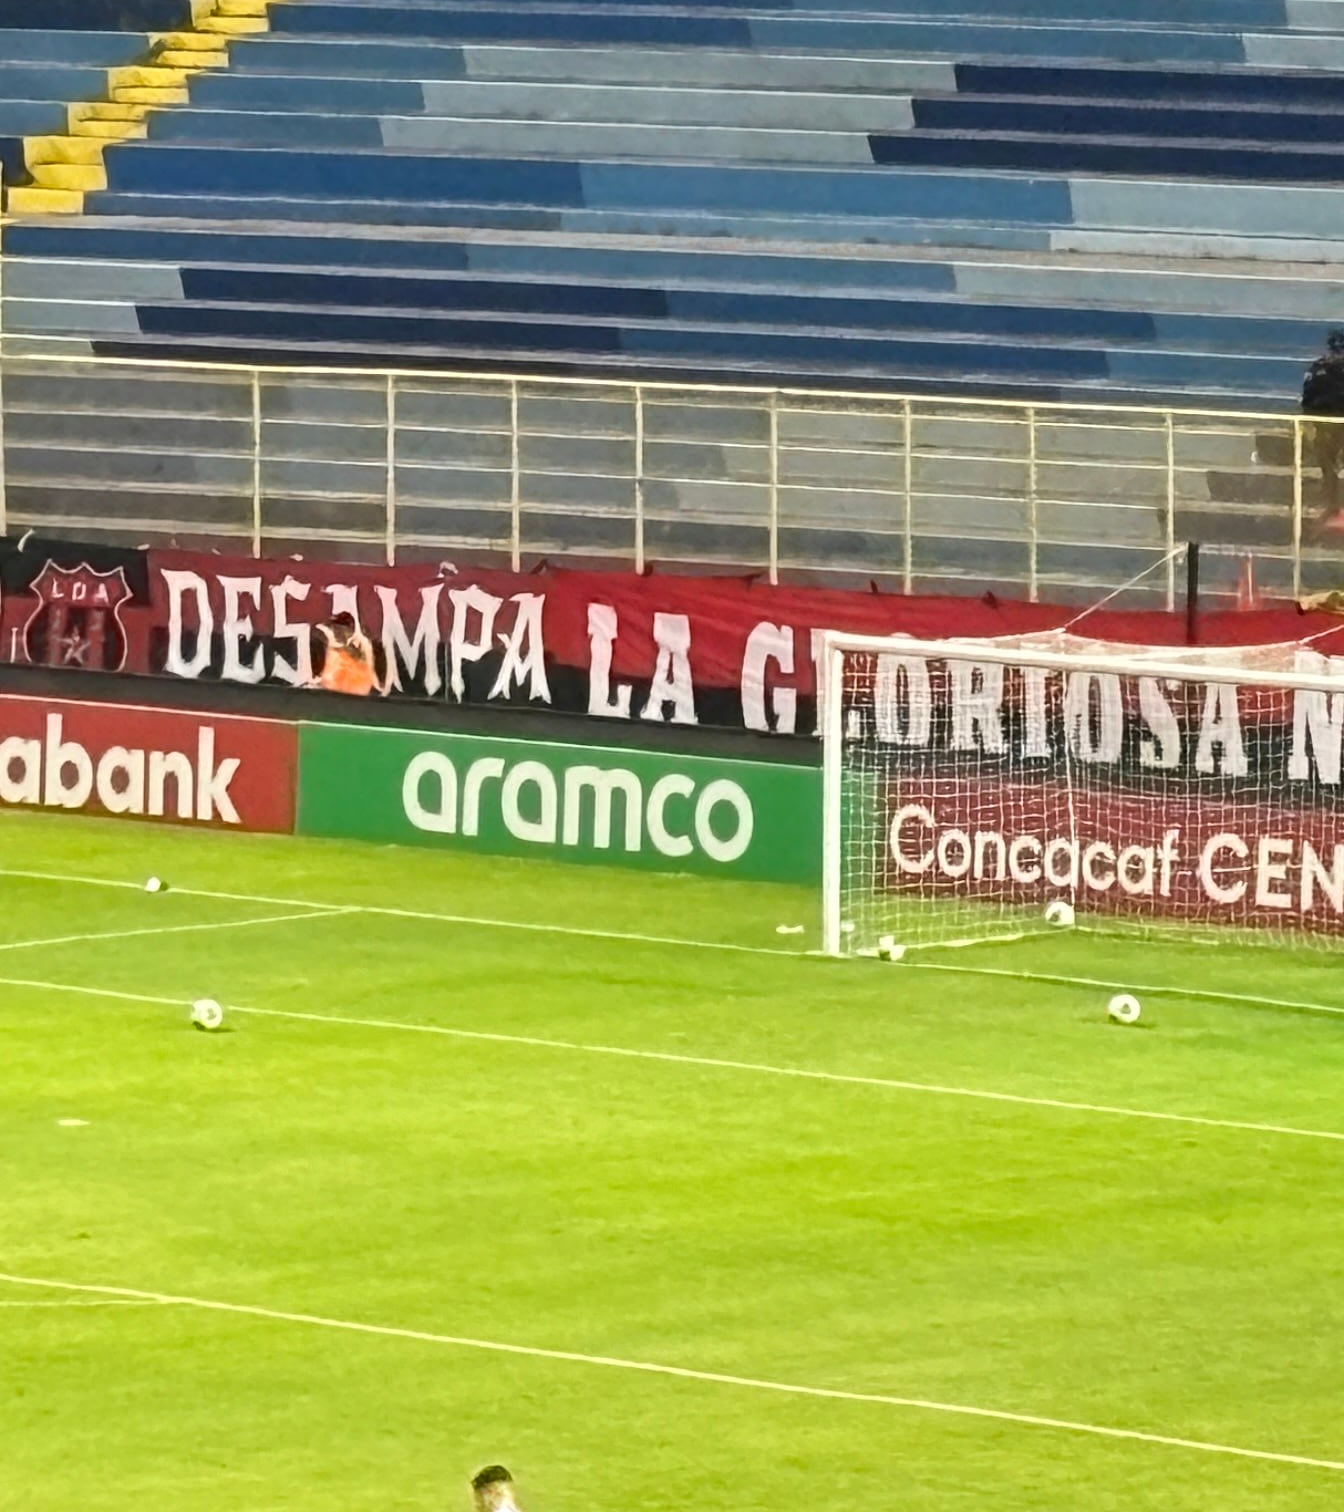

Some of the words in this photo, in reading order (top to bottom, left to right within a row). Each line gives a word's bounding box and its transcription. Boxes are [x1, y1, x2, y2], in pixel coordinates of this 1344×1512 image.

[585, 602, 699, 726] LA
[401, 749, 755, 863] aramco
[888, 802, 1182, 900] Concacaf
